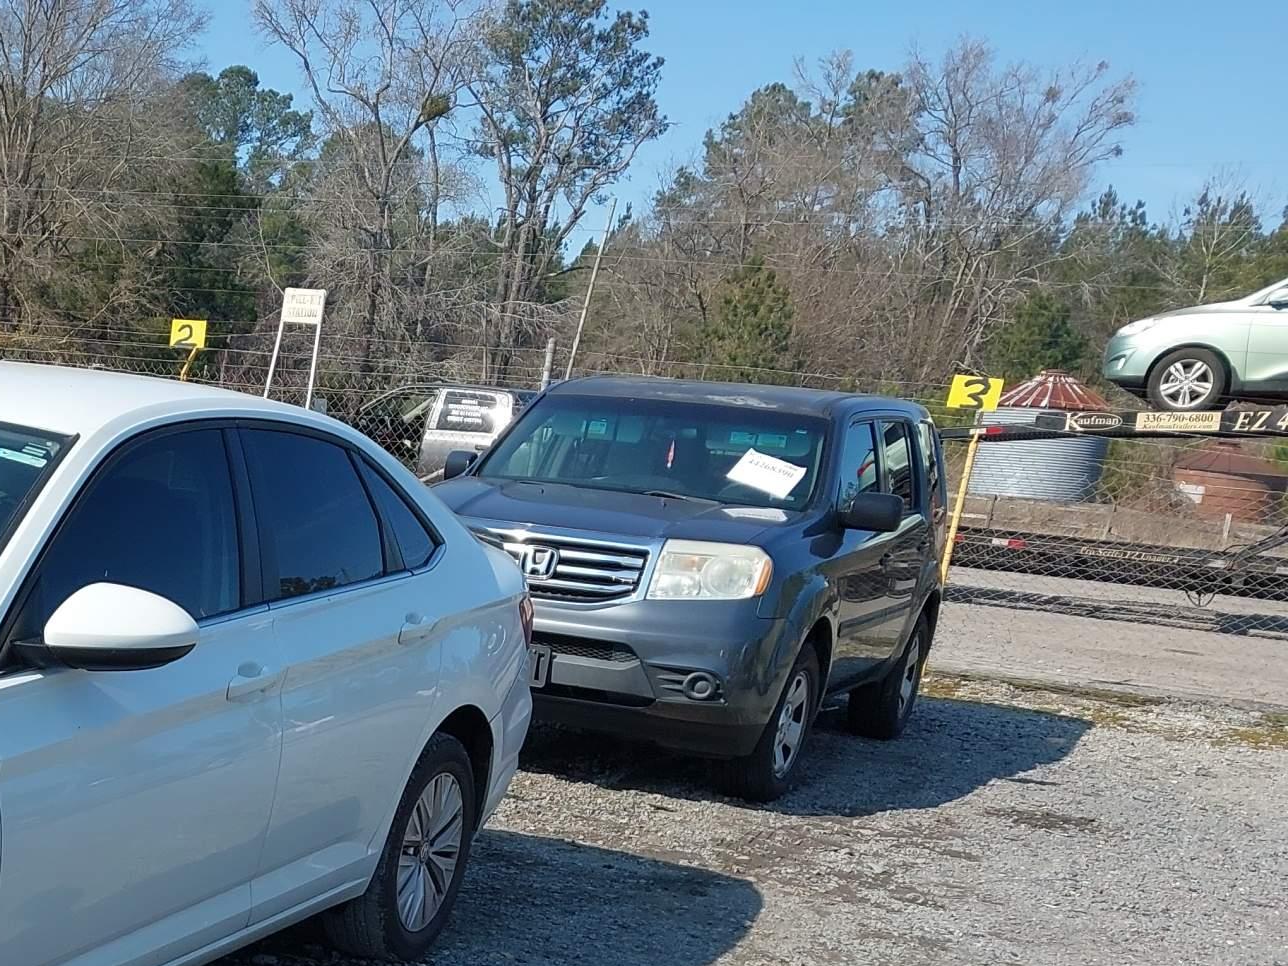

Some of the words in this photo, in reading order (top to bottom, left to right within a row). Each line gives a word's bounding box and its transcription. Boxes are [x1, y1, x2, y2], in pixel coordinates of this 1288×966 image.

[173, 324, 198, 346] 2
[959, 377, 992, 409] 3
[1064, 411, 1123, 432] Kaufman
[1142, 413, 1214, 424] 336-790-6800
[1233, 411, 1272, 432] EZ
